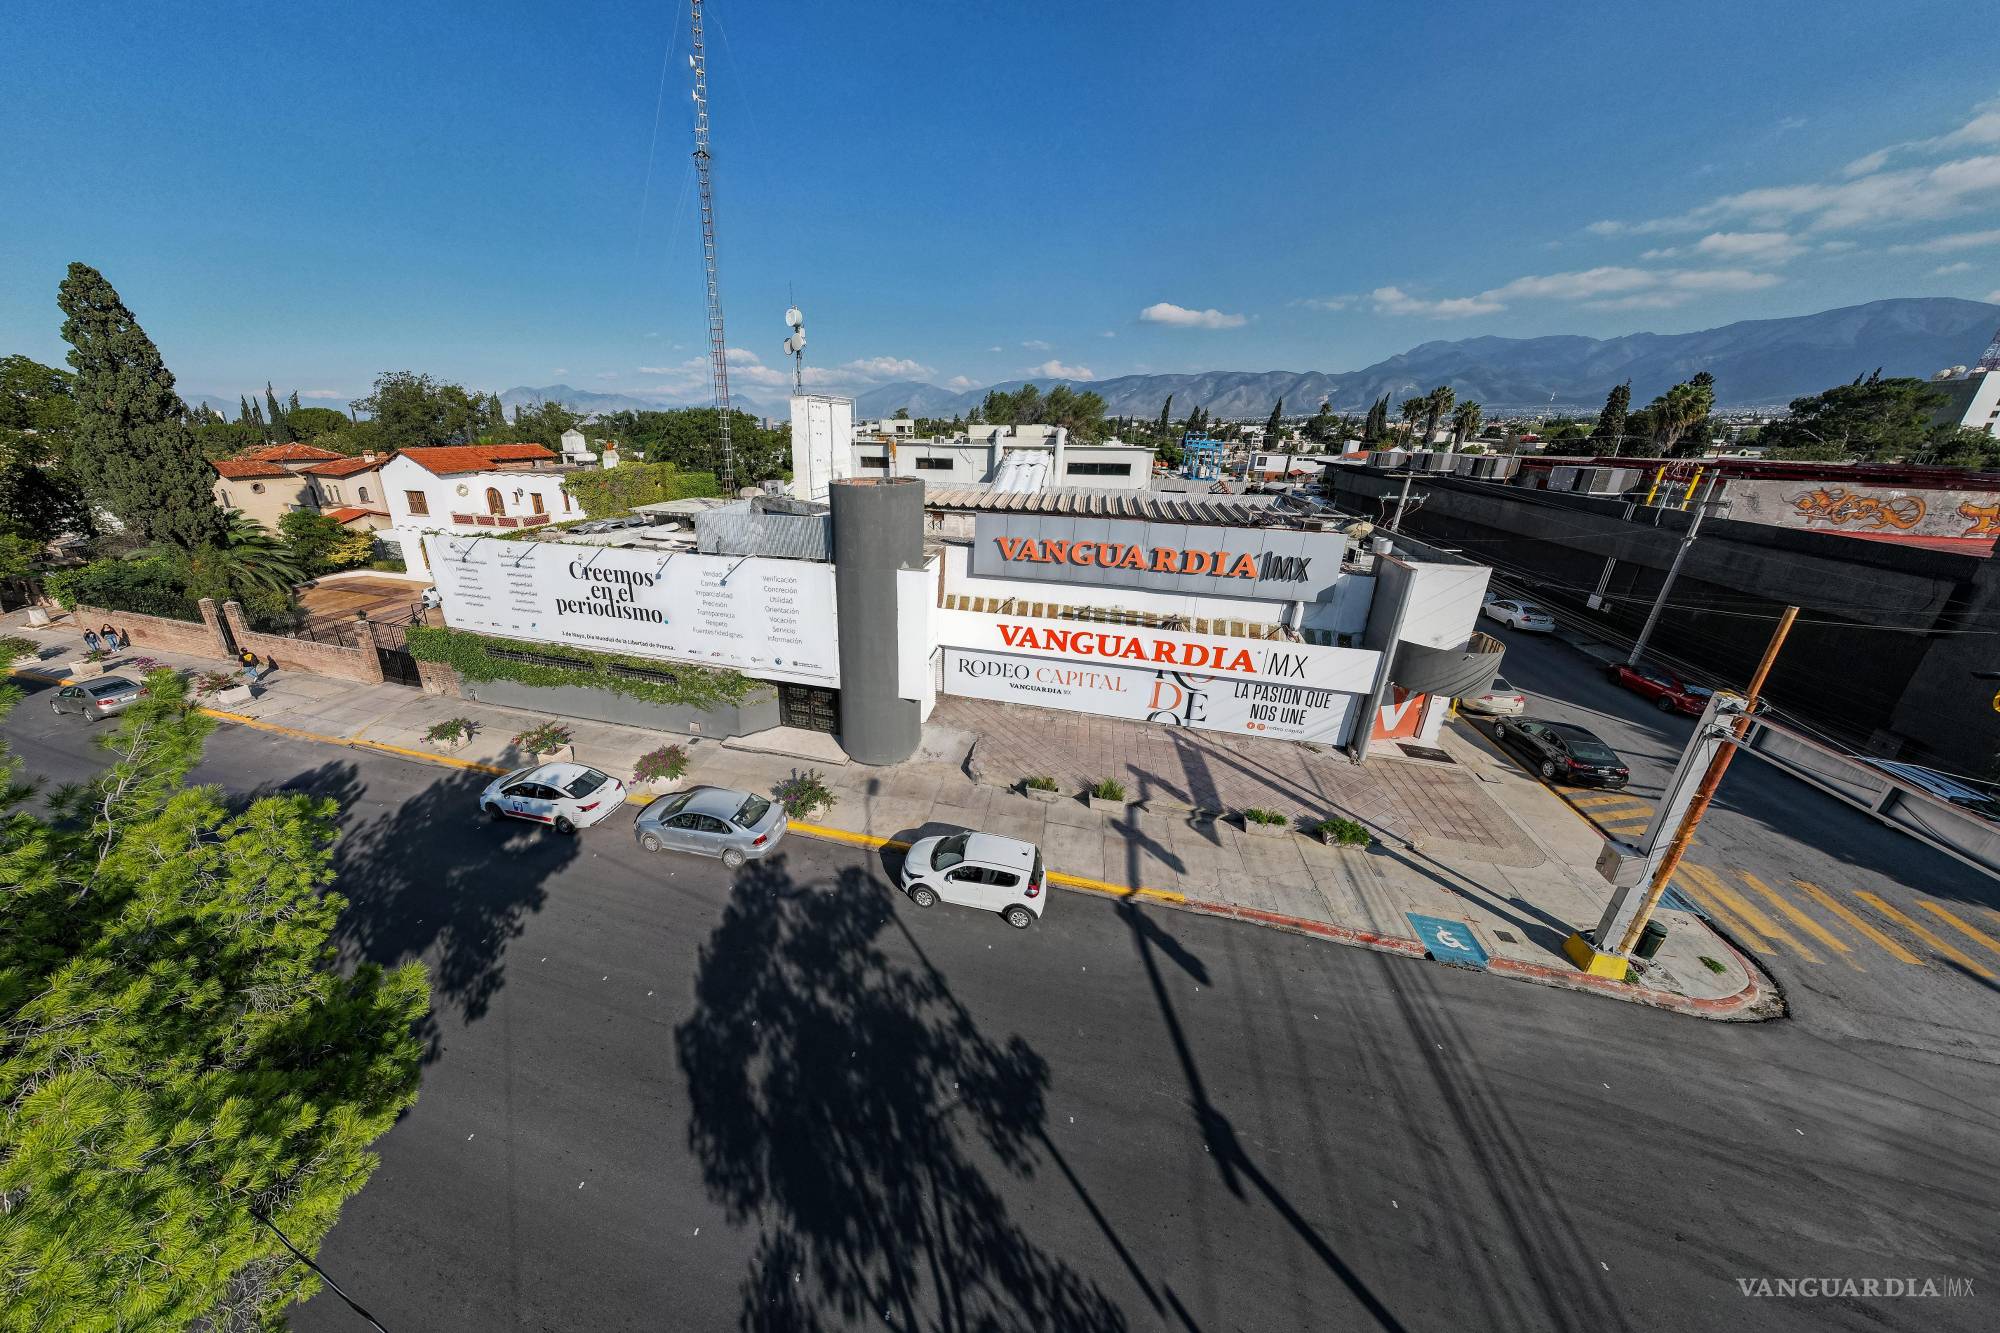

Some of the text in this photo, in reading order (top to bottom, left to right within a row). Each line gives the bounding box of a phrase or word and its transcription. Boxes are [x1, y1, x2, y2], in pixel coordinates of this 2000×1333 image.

[996, 537, 1259, 581] VANGUARDIA
[569, 561, 654, 587] Creemos
[762, 575, 797, 584] Verificación
[591, 583, 635, 603] en el
[763, 586, 798, 594] Concreción
[769, 596, 794, 604] Utilidad
[556, 597, 668, 624] periodismo.
[764, 606, 800, 615] Orientación
[769, 616, 797, 625] Vocación
[772, 626, 795, 634] Servicio
[767, 635, 803, 645] Información
[997, 624, 1258, 673] VANGUARDIA
[959, 658, 1127, 692] RODEO CAPITAL
[1009, 682, 1062, 695] VANGUARDIA
[1234, 682, 1249, 699] LA
[1305, 690, 1333, 709] QUE
[1249, 703, 1308, 726] NOS UNE
